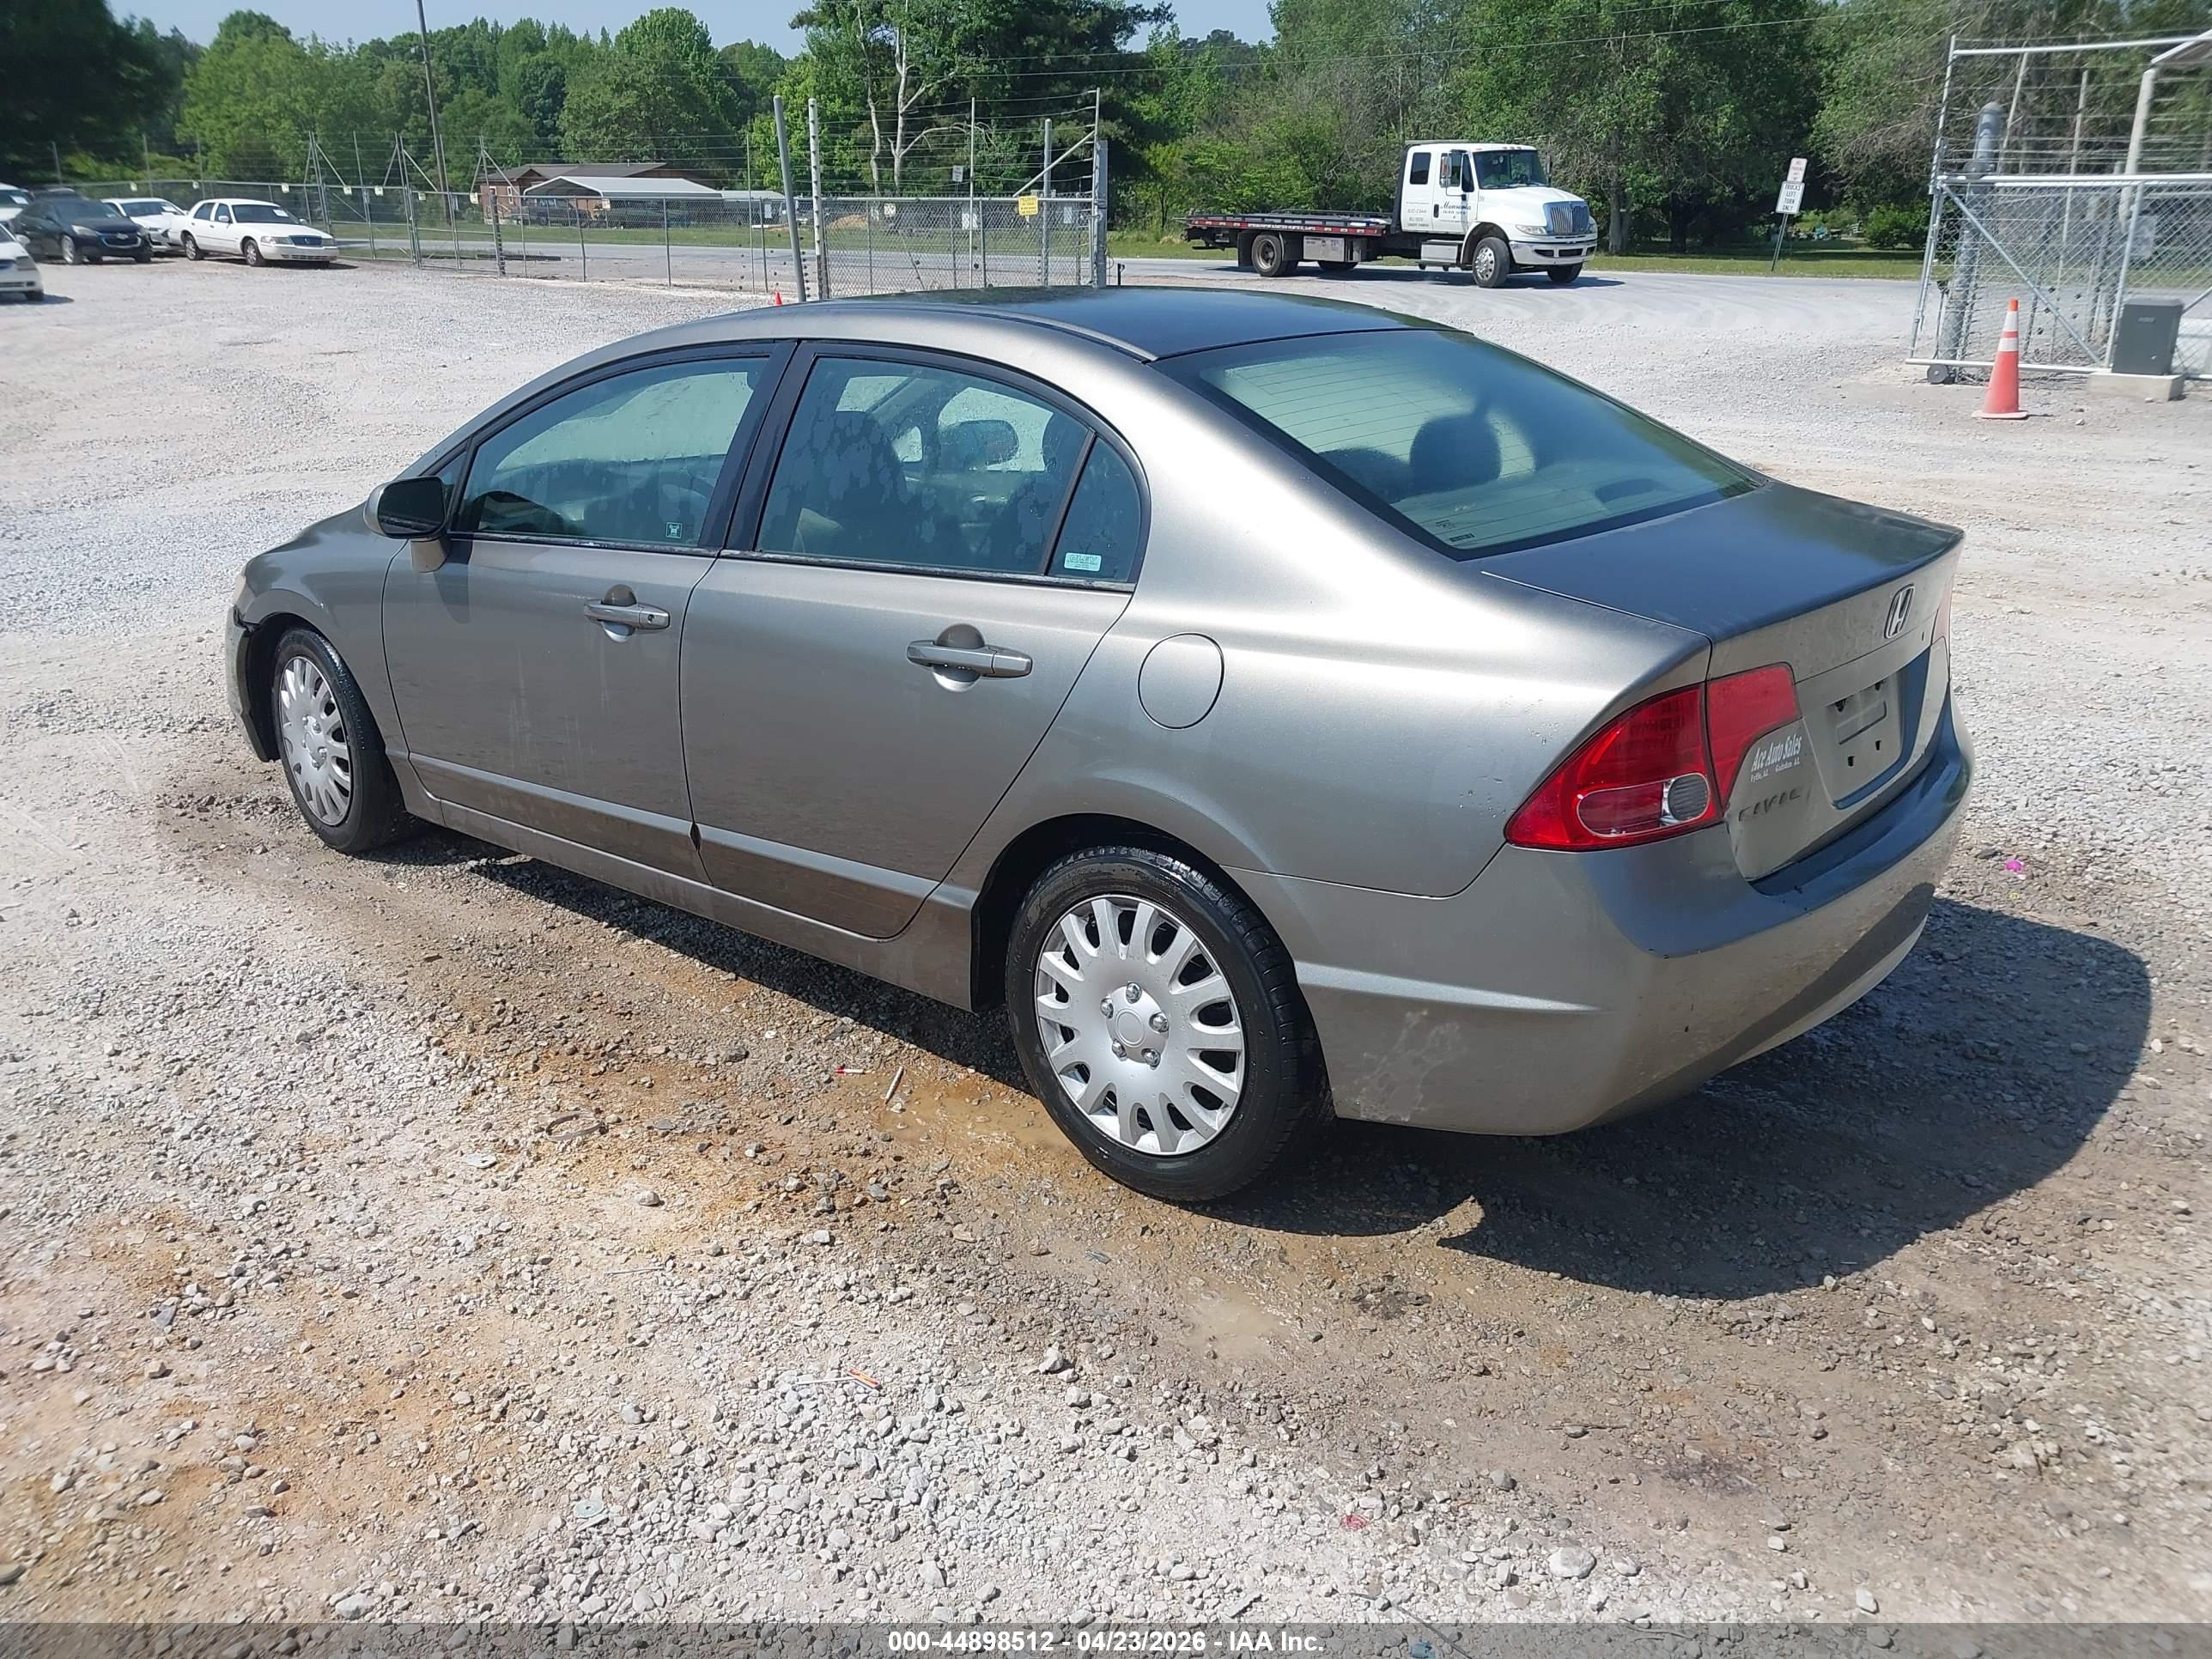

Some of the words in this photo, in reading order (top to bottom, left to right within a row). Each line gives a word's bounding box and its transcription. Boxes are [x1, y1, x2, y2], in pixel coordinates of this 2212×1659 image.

[1751, 747, 1767, 772] Ace
[1765, 741, 1784, 766] Auto
[1782, 734, 1802, 760] Sales
[1738, 787, 1801, 821] CIVIC
